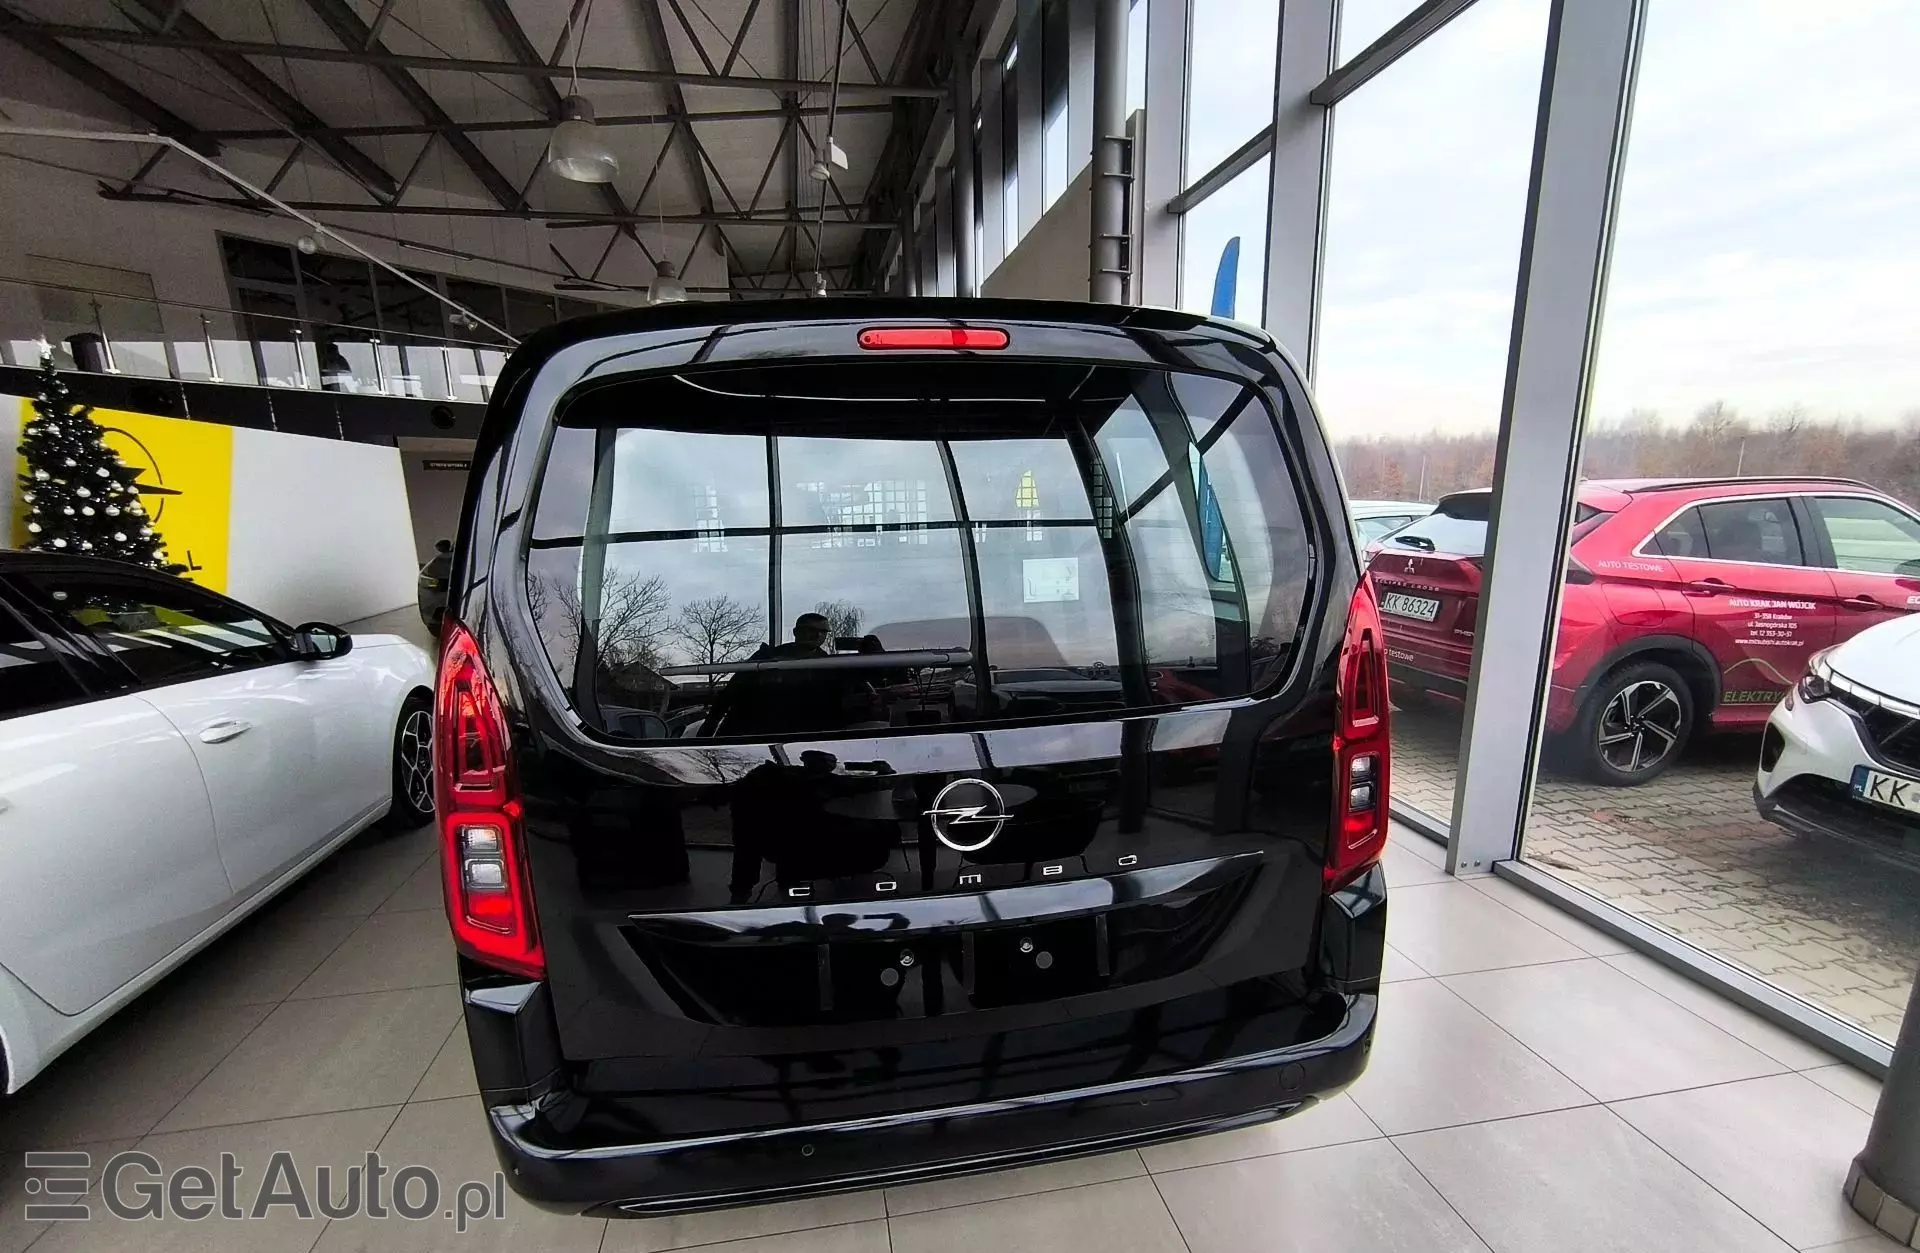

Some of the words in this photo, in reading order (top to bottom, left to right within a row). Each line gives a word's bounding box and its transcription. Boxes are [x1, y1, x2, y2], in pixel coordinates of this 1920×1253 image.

[1598, 560, 1621, 569] AUTO
[1622, 561, 1665, 573] TESTOWE
[1386, 593, 1401, 609] KK
[1401, 597, 1437, 617] 86324
[1729, 599, 1749, 607] AUTO
[1750, 599, 1771, 608] KRAK
[1772, 600, 1787, 608] JAN
[1388, 648, 1414, 662] testowe
[1870, 774, 1911, 807] KK
[788, 854, 1137, 897] COMBO
